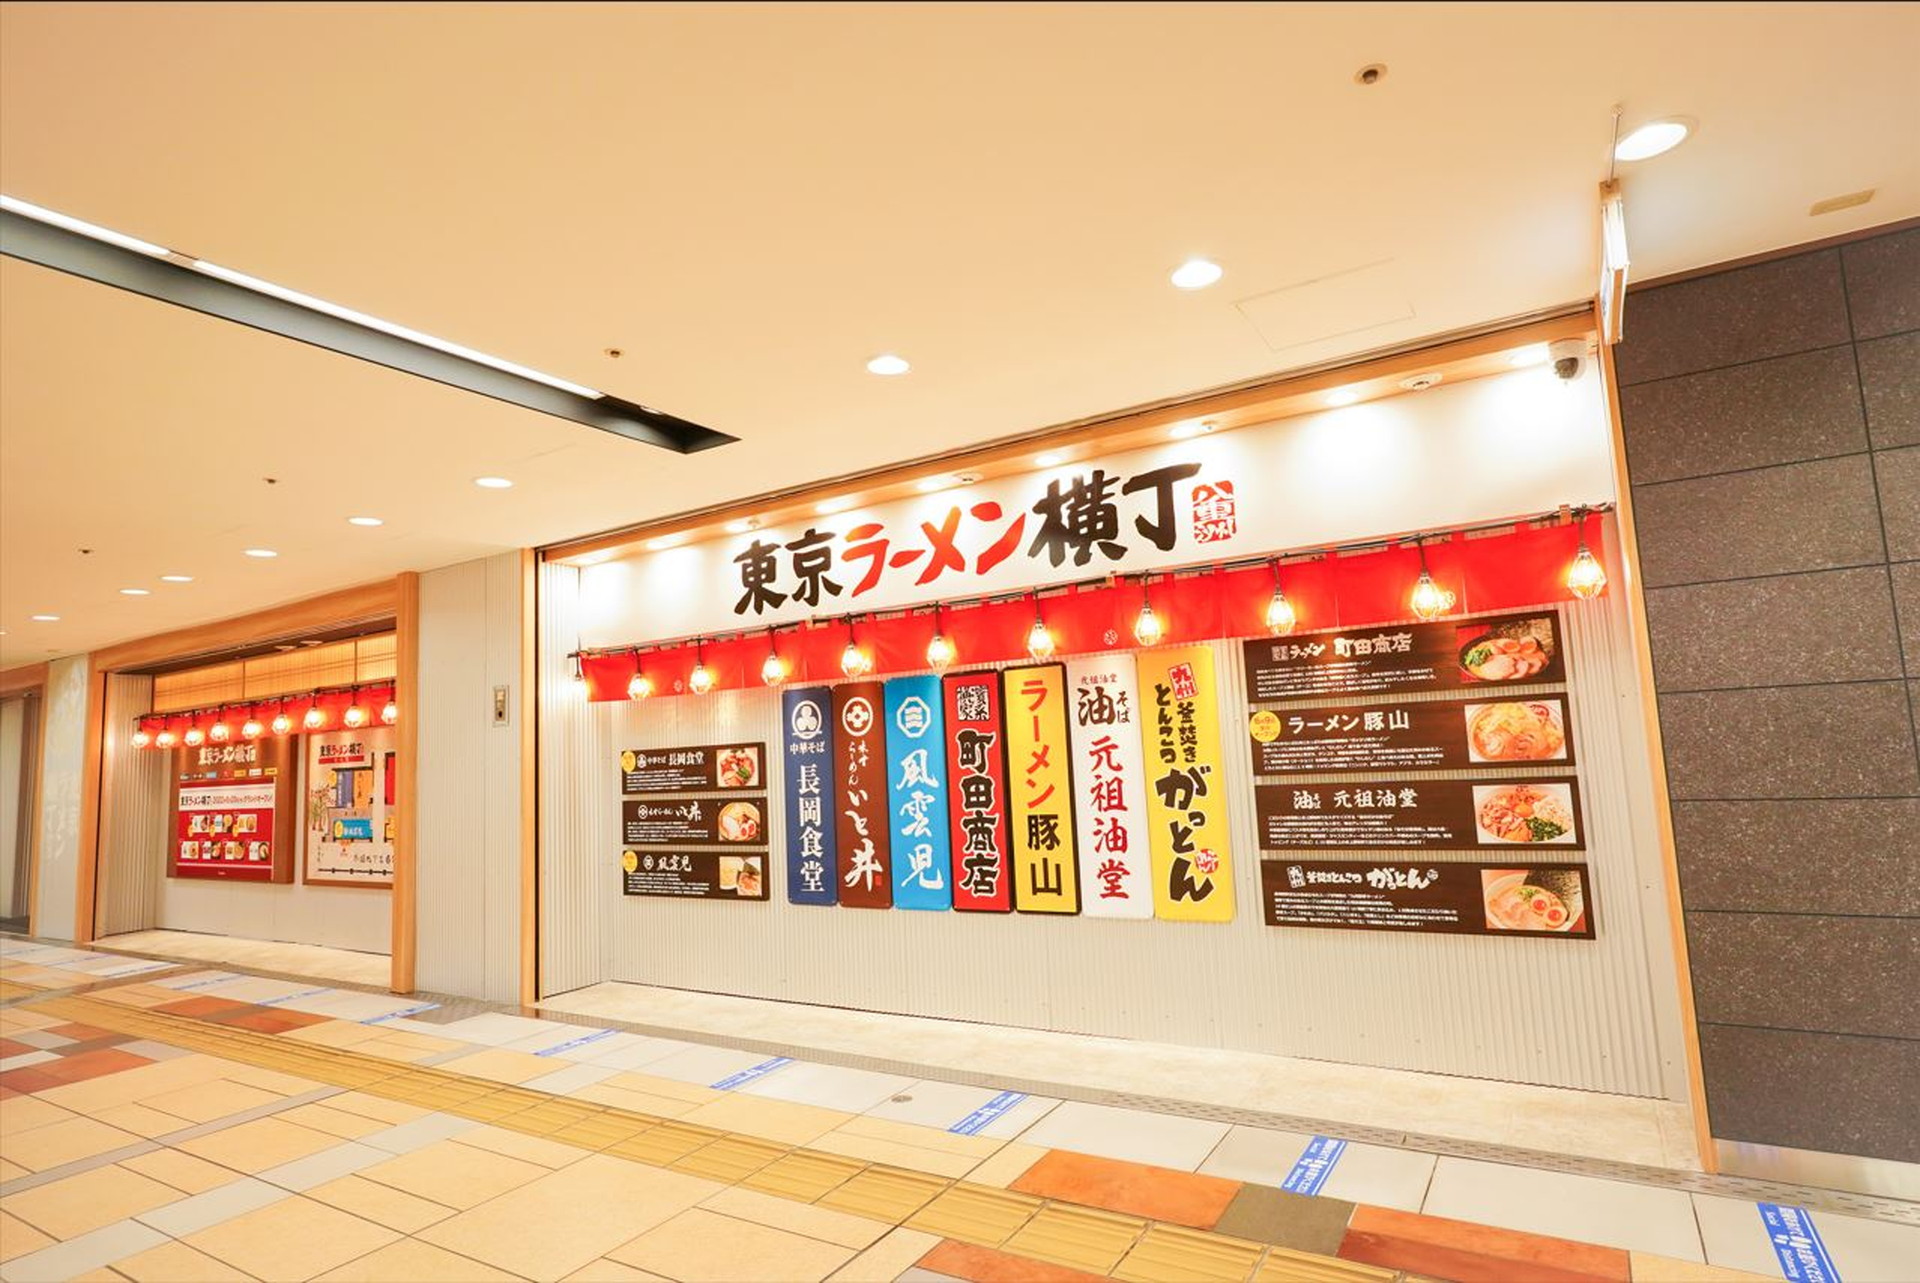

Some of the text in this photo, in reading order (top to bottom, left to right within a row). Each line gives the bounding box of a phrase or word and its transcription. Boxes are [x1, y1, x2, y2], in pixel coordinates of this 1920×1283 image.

[733, 462, 1202, 615] 東京ラーメン横丁
[789, 741, 826, 755] 中華そば
[1155, 684, 1177, 764] とんこつ
[1288, 710, 1410, 735] ラーメン 豚山
[797, 763, 825, 892] 長岡食堂
[957, 729, 1000, 897] 町田商店
[1089, 735, 1130, 899] 元祖油堂
[1155, 766, 1215, 902] がっとん
[1333, 788, 1418, 808] 元祖油堂
